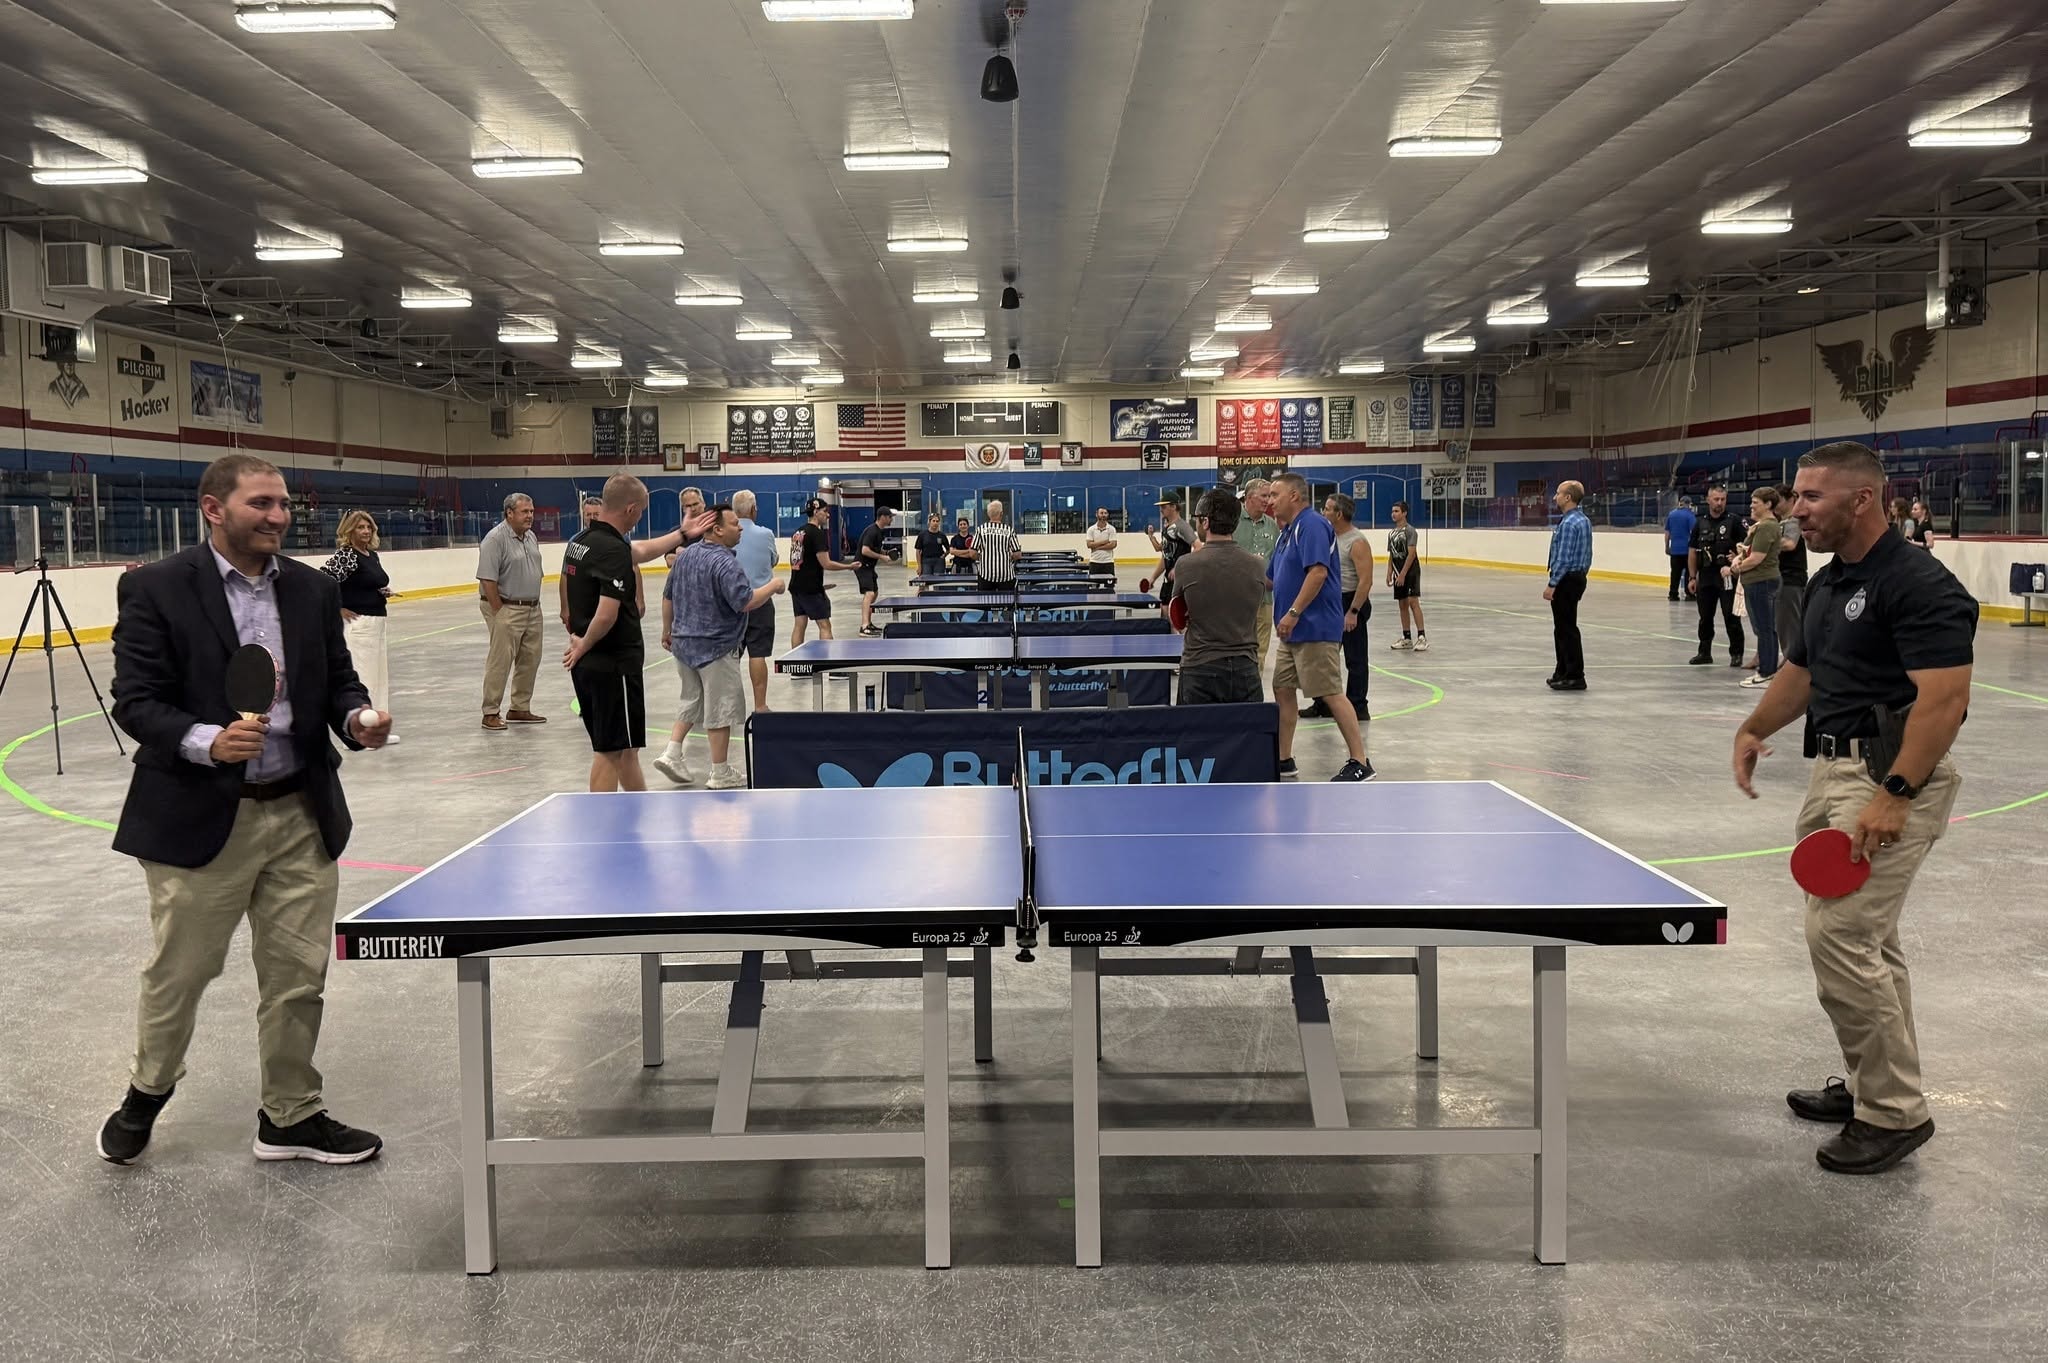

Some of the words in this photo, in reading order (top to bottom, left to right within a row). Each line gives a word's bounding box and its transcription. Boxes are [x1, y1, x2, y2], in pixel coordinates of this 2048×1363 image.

[123, 360, 162, 378] PILGRIM
[120, 396, 170, 421] Hockey
[704, 447, 715, 459] 17
[1151, 453, 1160, 461] 30
[1220, 457, 1234, 465] HOME
[1235, 457, 1242, 465] OF
[1251, 457, 1268, 465] RHODE
[1269, 456, 1287, 464] ISLAND
[1466, 488, 1487, 496] BLUES
[782, 664, 813, 673] BUTTERFLY
[976, 689, 987, 704] 2
[912, 932, 950, 945] Europa
[952, 932, 966, 942] 25
[1064, 931, 1102, 944] Europa
[1104, 931, 1117, 942] 25
[358, 936, 445, 958] BUTTERFLY
